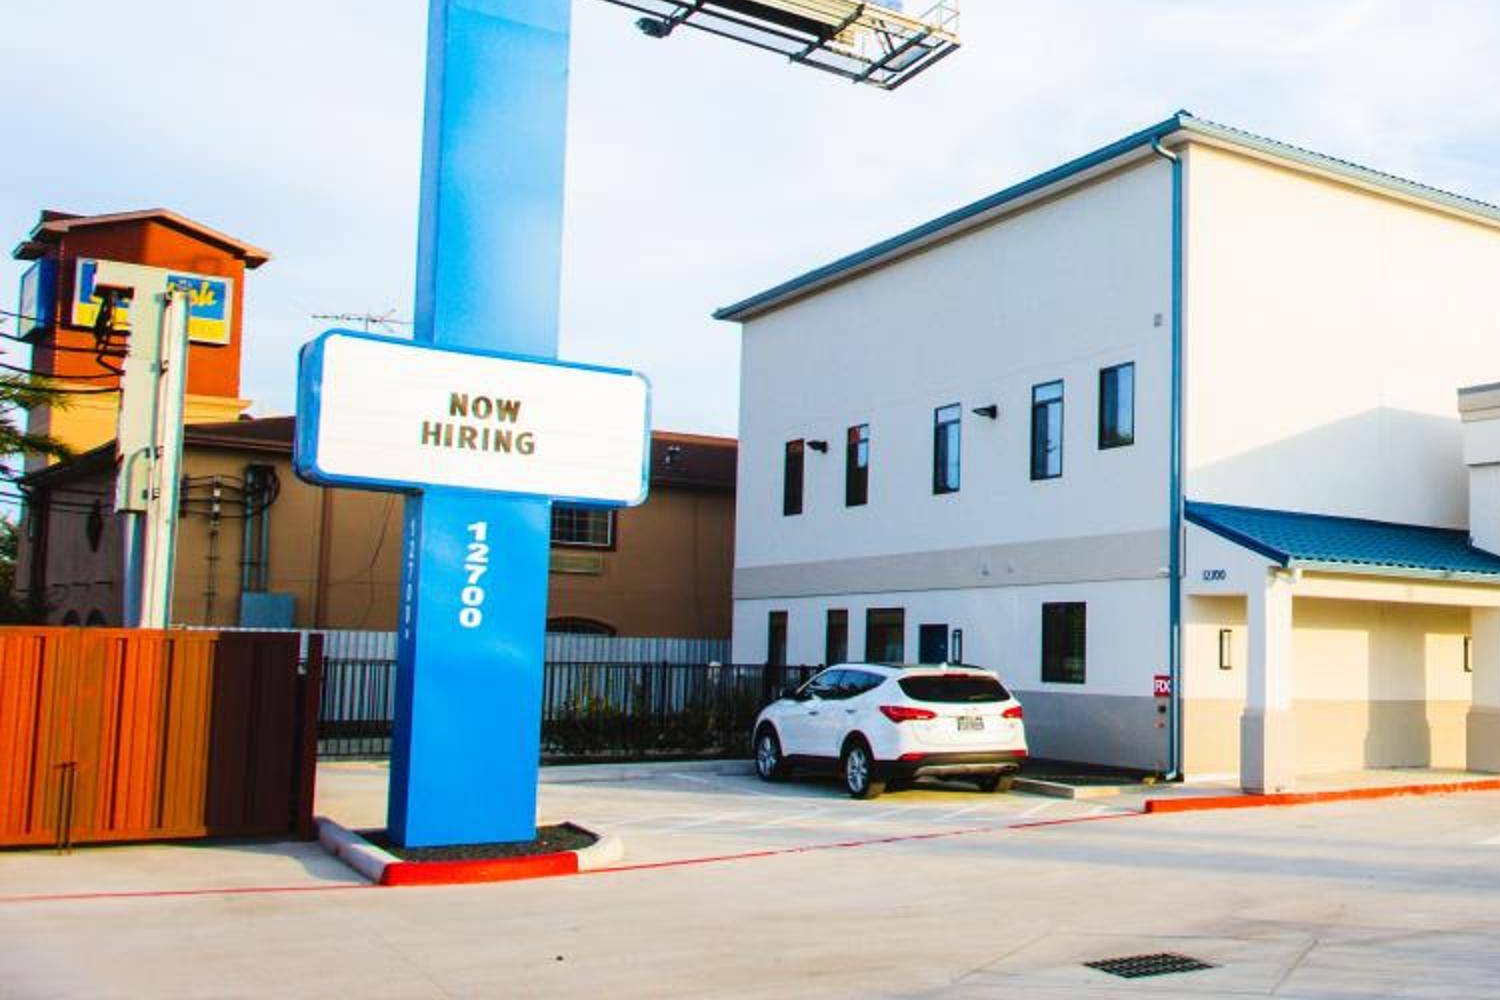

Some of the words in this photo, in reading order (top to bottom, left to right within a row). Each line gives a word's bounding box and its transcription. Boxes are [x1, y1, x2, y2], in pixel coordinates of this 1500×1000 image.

[449, 391, 522, 424] NOW
[420, 420, 536, 456] HIRING
[458, 520, 491, 629] 12700
